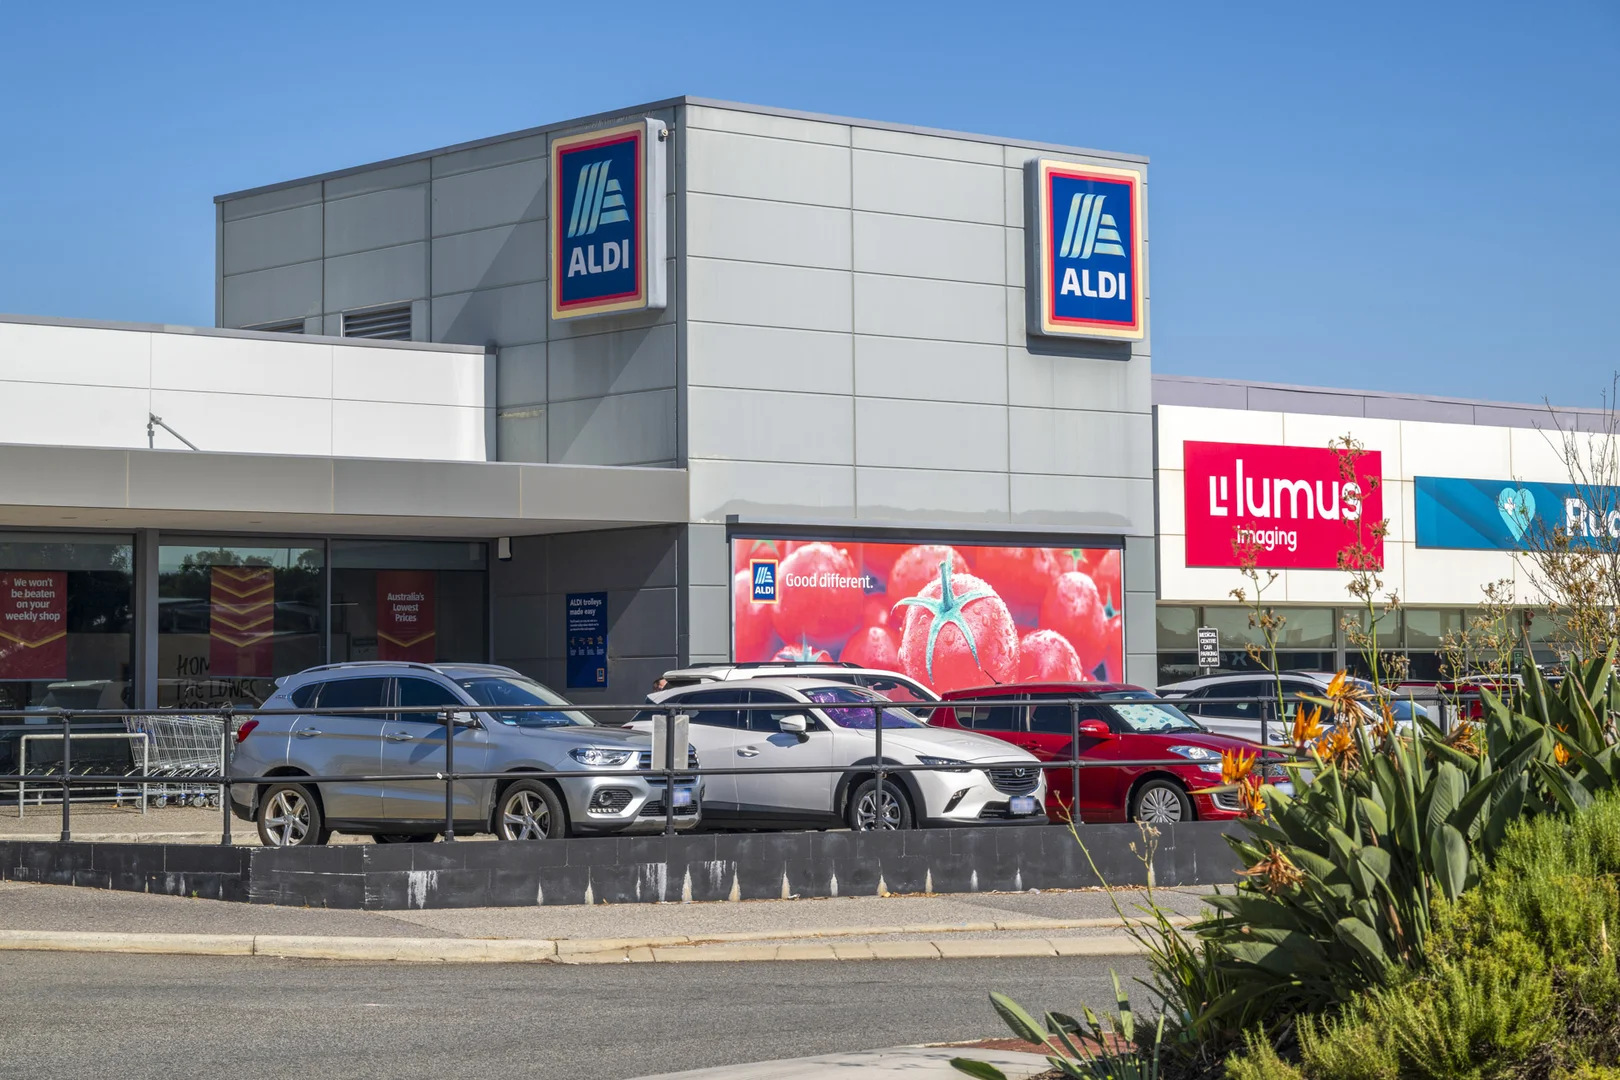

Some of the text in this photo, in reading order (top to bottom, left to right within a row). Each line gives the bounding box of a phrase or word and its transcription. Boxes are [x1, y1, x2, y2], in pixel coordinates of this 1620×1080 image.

[568, 239, 629, 278] ALDI
[1060, 268, 1126, 300] ALDI
[1236, 459, 1362, 520] lumus
[1237, 525, 1297, 552] imaging
[14, 578, 53, 587] We won't
[785, 573, 874, 589] Good different.
[11, 589, 55, 598] be beaten
[755, 586, 774, 594] ALDI
[387, 592, 425, 601] Australia's
[30, 601, 50, 610] your
[393, 603, 419, 611] Lowest
[5, 611, 60, 622] weekly shop
[395, 612, 417, 622] Prices
